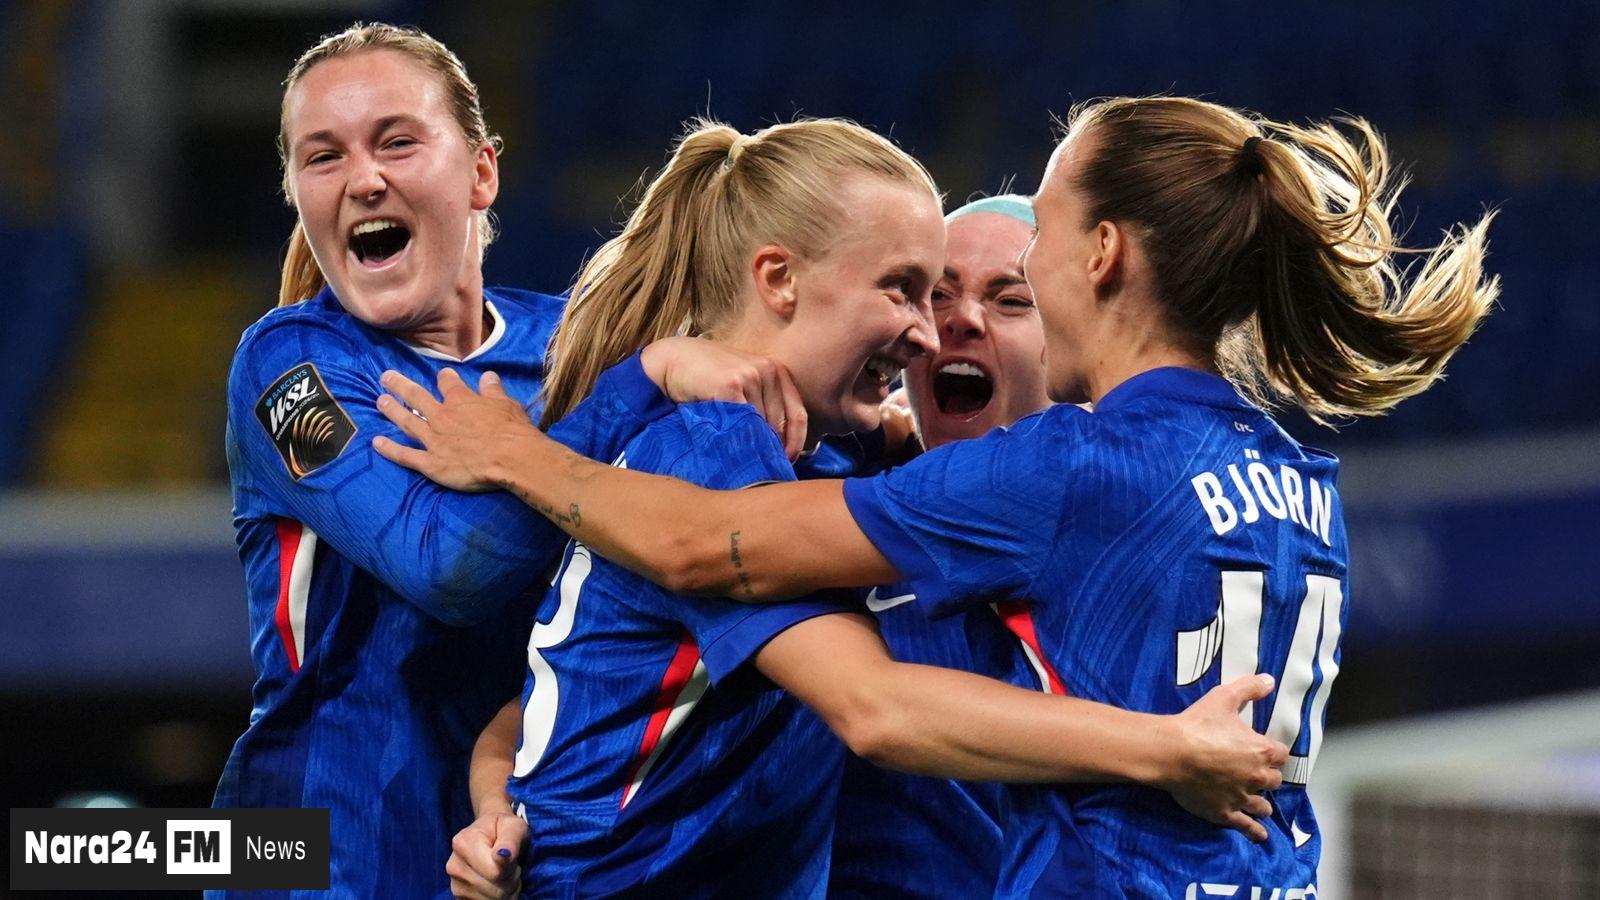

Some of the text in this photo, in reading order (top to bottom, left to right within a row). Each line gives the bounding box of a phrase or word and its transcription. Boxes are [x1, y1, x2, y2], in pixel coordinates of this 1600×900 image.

[269, 376, 318, 434] WSL
[271, 368, 308, 399] BARCLAYS
[1190, 448, 1332, 547] BJÖRN
[1176, 570, 1343, 786] 14
